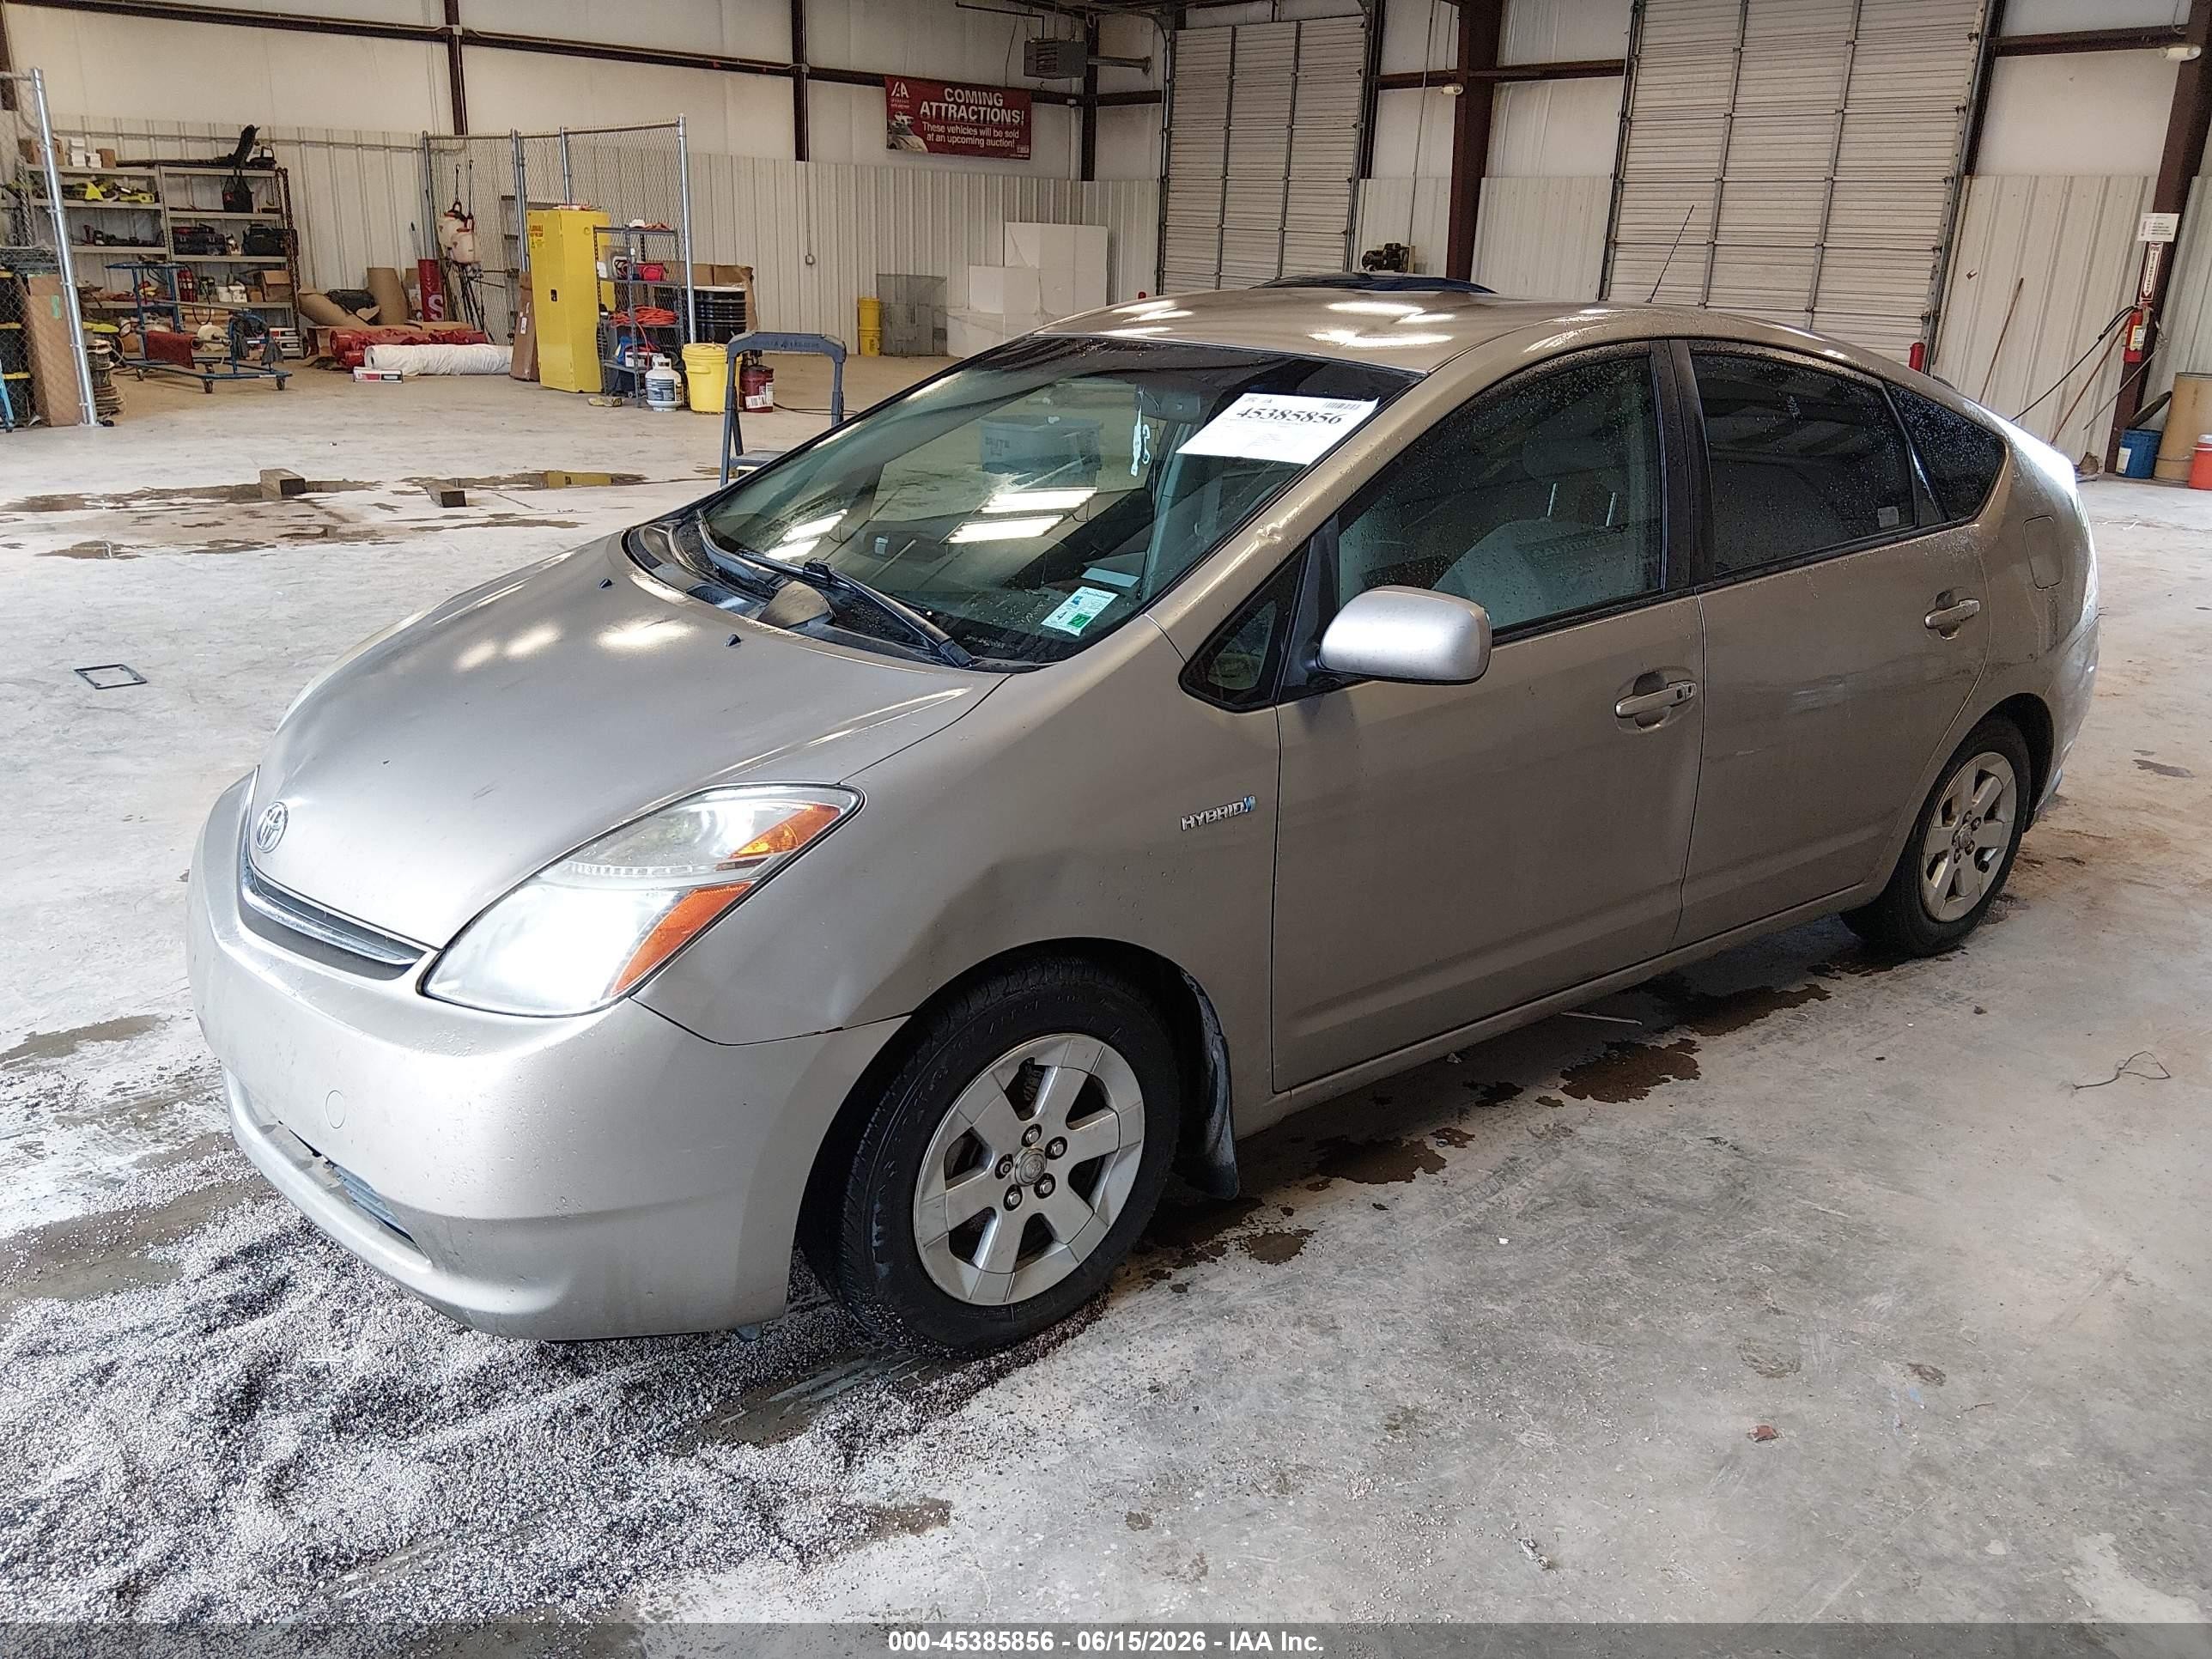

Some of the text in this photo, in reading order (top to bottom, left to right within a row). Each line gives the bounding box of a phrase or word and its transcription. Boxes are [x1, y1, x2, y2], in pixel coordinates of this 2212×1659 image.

[945, 88, 1004, 106] COMING
[920, 100, 1024, 124] ATTRACTIONS!
[922, 121, 1019, 139] These vehicles will be sold
[927, 132, 1015, 149] at an upcoming auction!
[1236, 407, 1346, 425] 45385856
[1181, 800, 1245, 831] HYBRID
